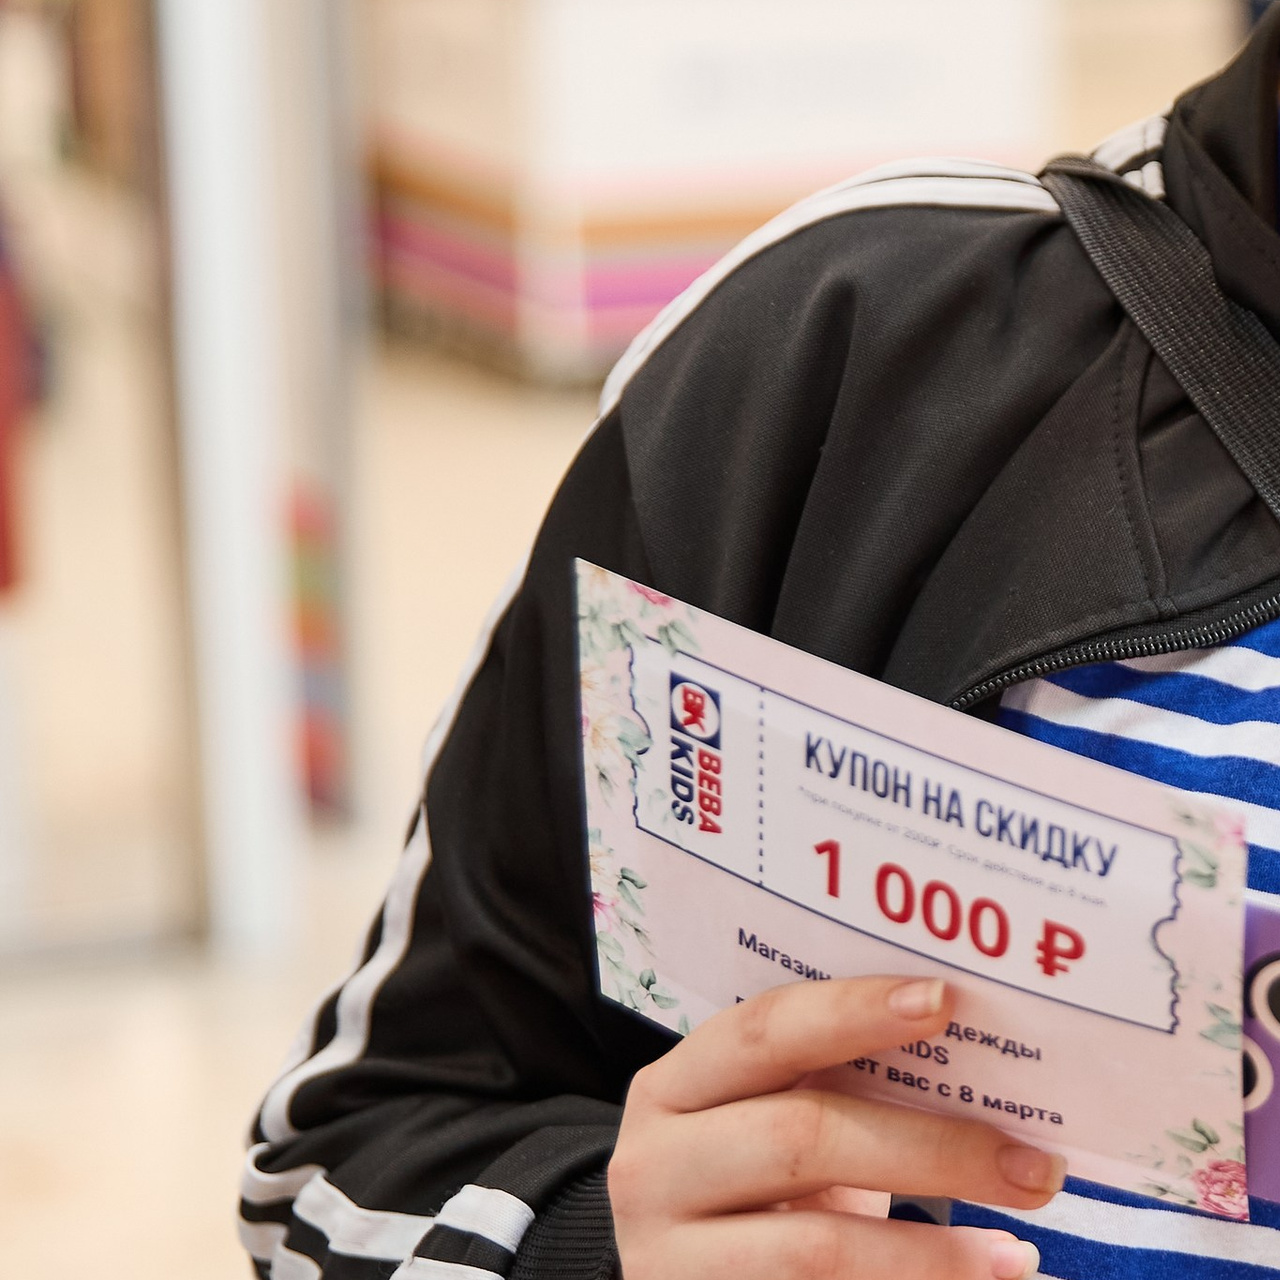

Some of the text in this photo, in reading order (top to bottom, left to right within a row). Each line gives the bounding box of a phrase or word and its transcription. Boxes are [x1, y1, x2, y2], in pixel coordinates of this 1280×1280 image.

[670, 735, 695, 825] KIDS
[698, 748, 722, 834] BEBA
[805, 731, 1118, 877] КУПОН НА СКИДКУ
[814, 838, 841, 899] 1
[875, 862, 1010, 959] 000
[945, 1021, 1042, 1062] дежды
[886, 1066, 930, 1091] вас
[938, 1082, 952, 1097] с
[960, 1085, 973, 1103] 8
[983, 1094, 1063, 1125] марта
